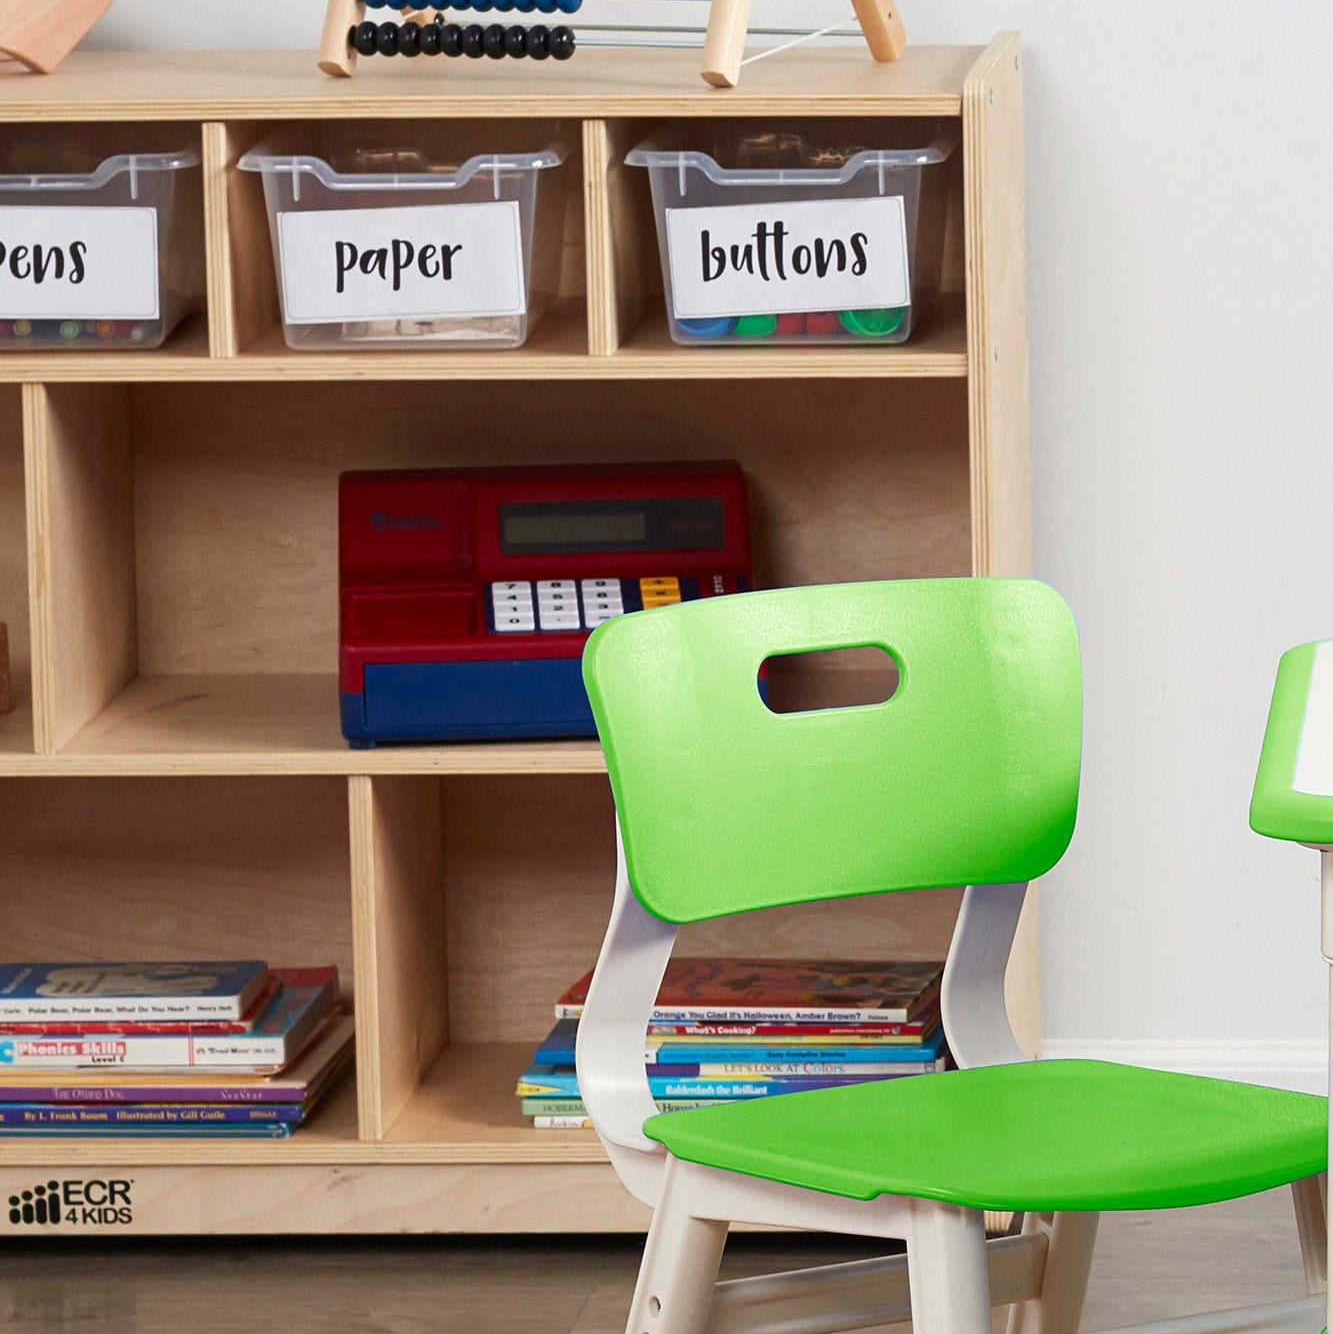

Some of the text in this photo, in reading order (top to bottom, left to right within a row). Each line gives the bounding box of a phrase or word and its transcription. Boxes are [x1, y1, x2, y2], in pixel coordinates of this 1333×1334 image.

[701, 220, 868, 282] buttons
[335, 238, 463, 293] paper
[654, 1011, 861, 1020] Orange You Glad It's Halloween, Amber Brown?
[684, 1026, 756, 1035] What's Cooking?
[18, 1042, 78, 1056] Phonics
[82, 1042, 125, 1055] Skills
[725, 1063, 845, 1074] LET'S LOOK AT Colors
[665, 1085, 768, 1095] Balderdash the Brilliant
[24, 1111, 225, 1120] By L. Frank Baum Illustrated by Gill Guile
[63, 1180, 132, 1205] ECR
[65, 1207, 132, 1224] 4 KIDS
